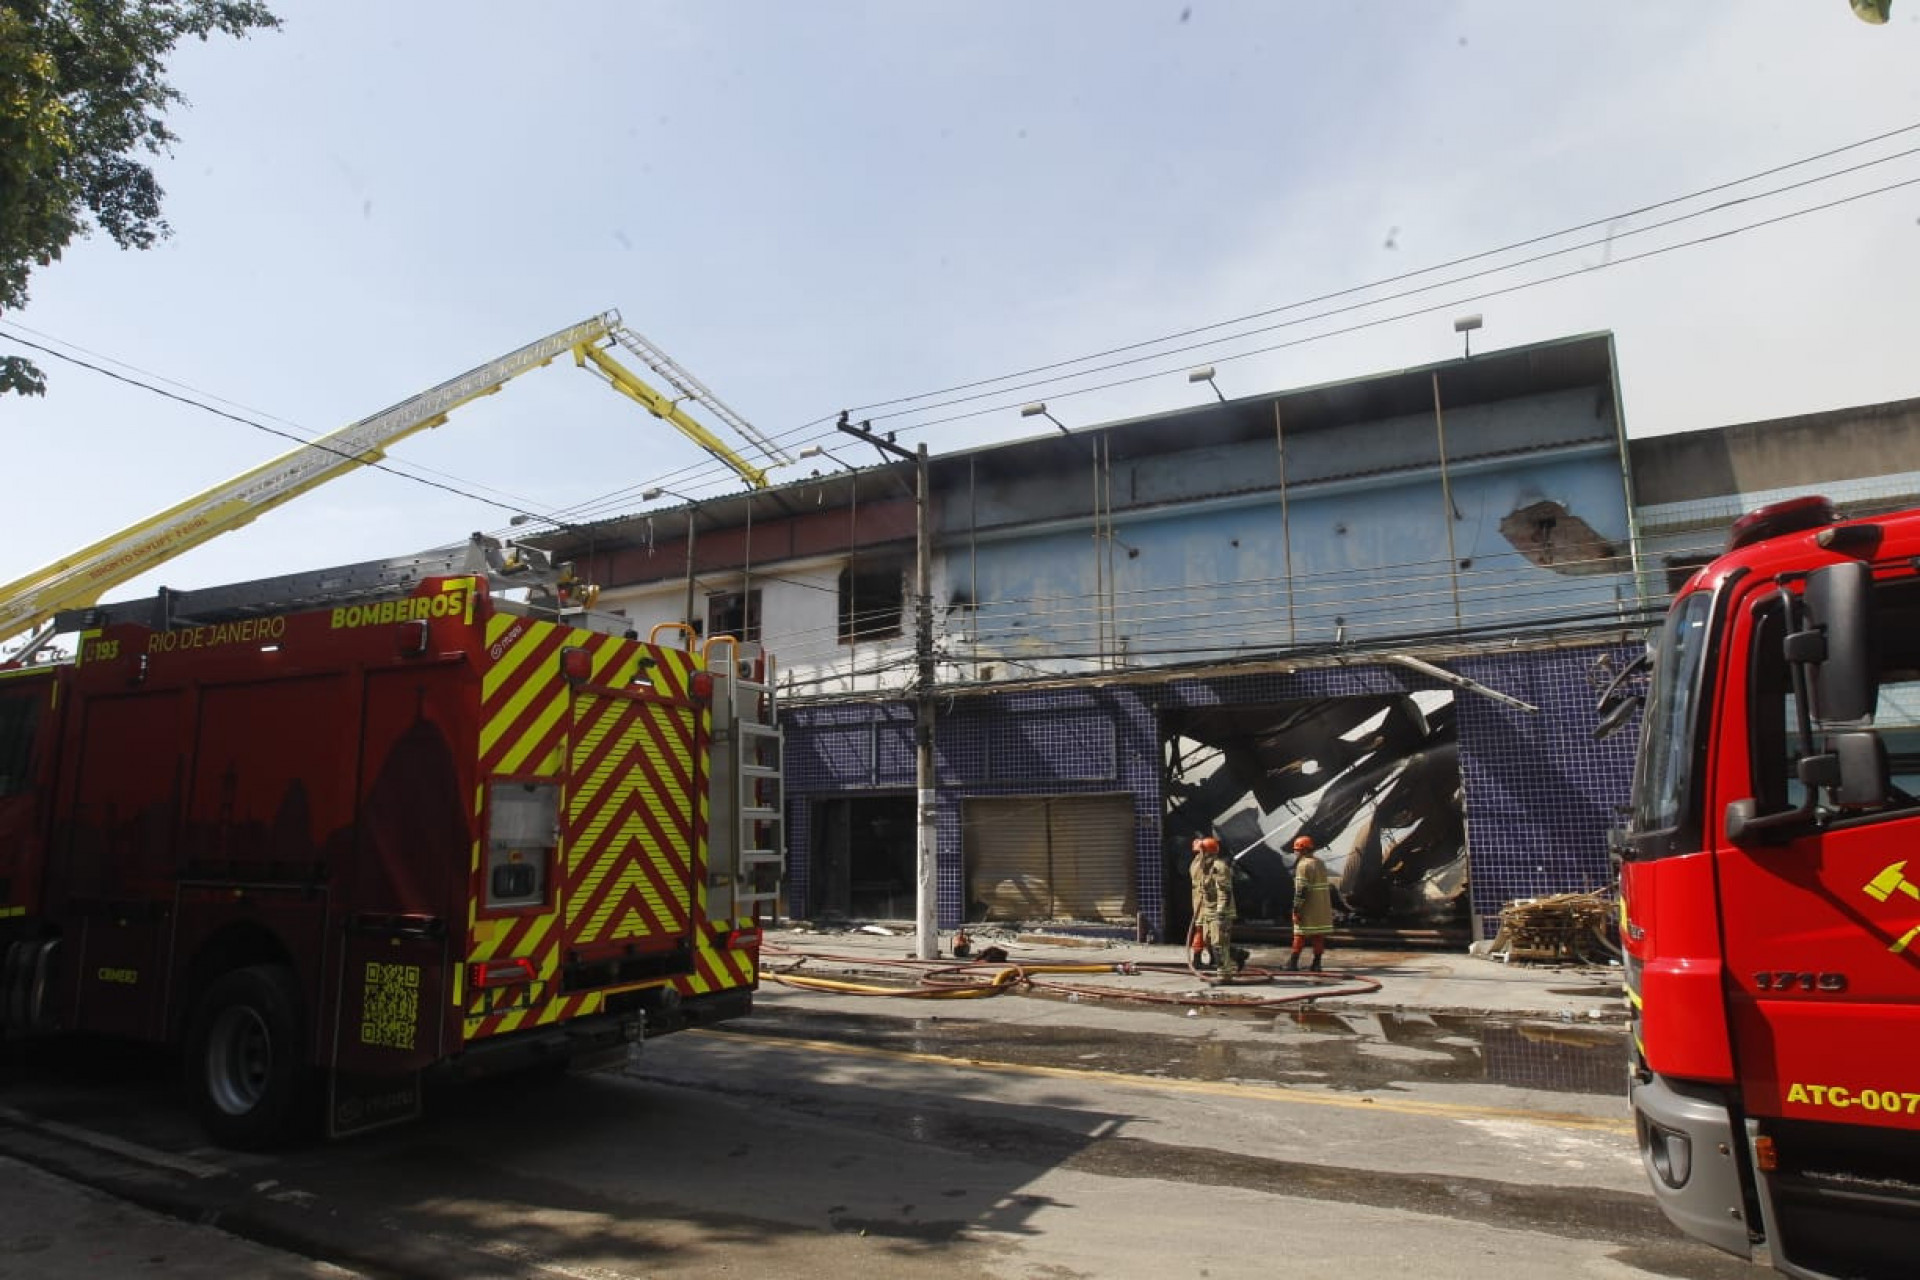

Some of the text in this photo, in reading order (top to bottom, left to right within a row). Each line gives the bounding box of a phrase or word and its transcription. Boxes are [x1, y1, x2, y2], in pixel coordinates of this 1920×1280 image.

[330, 592, 463, 629] BOMBEIROS
[97, 640, 120, 660] 193
[149, 616, 285, 652] RIO DE JANEIRO
[1786, 1082, 1920, 1115] ATC-007
